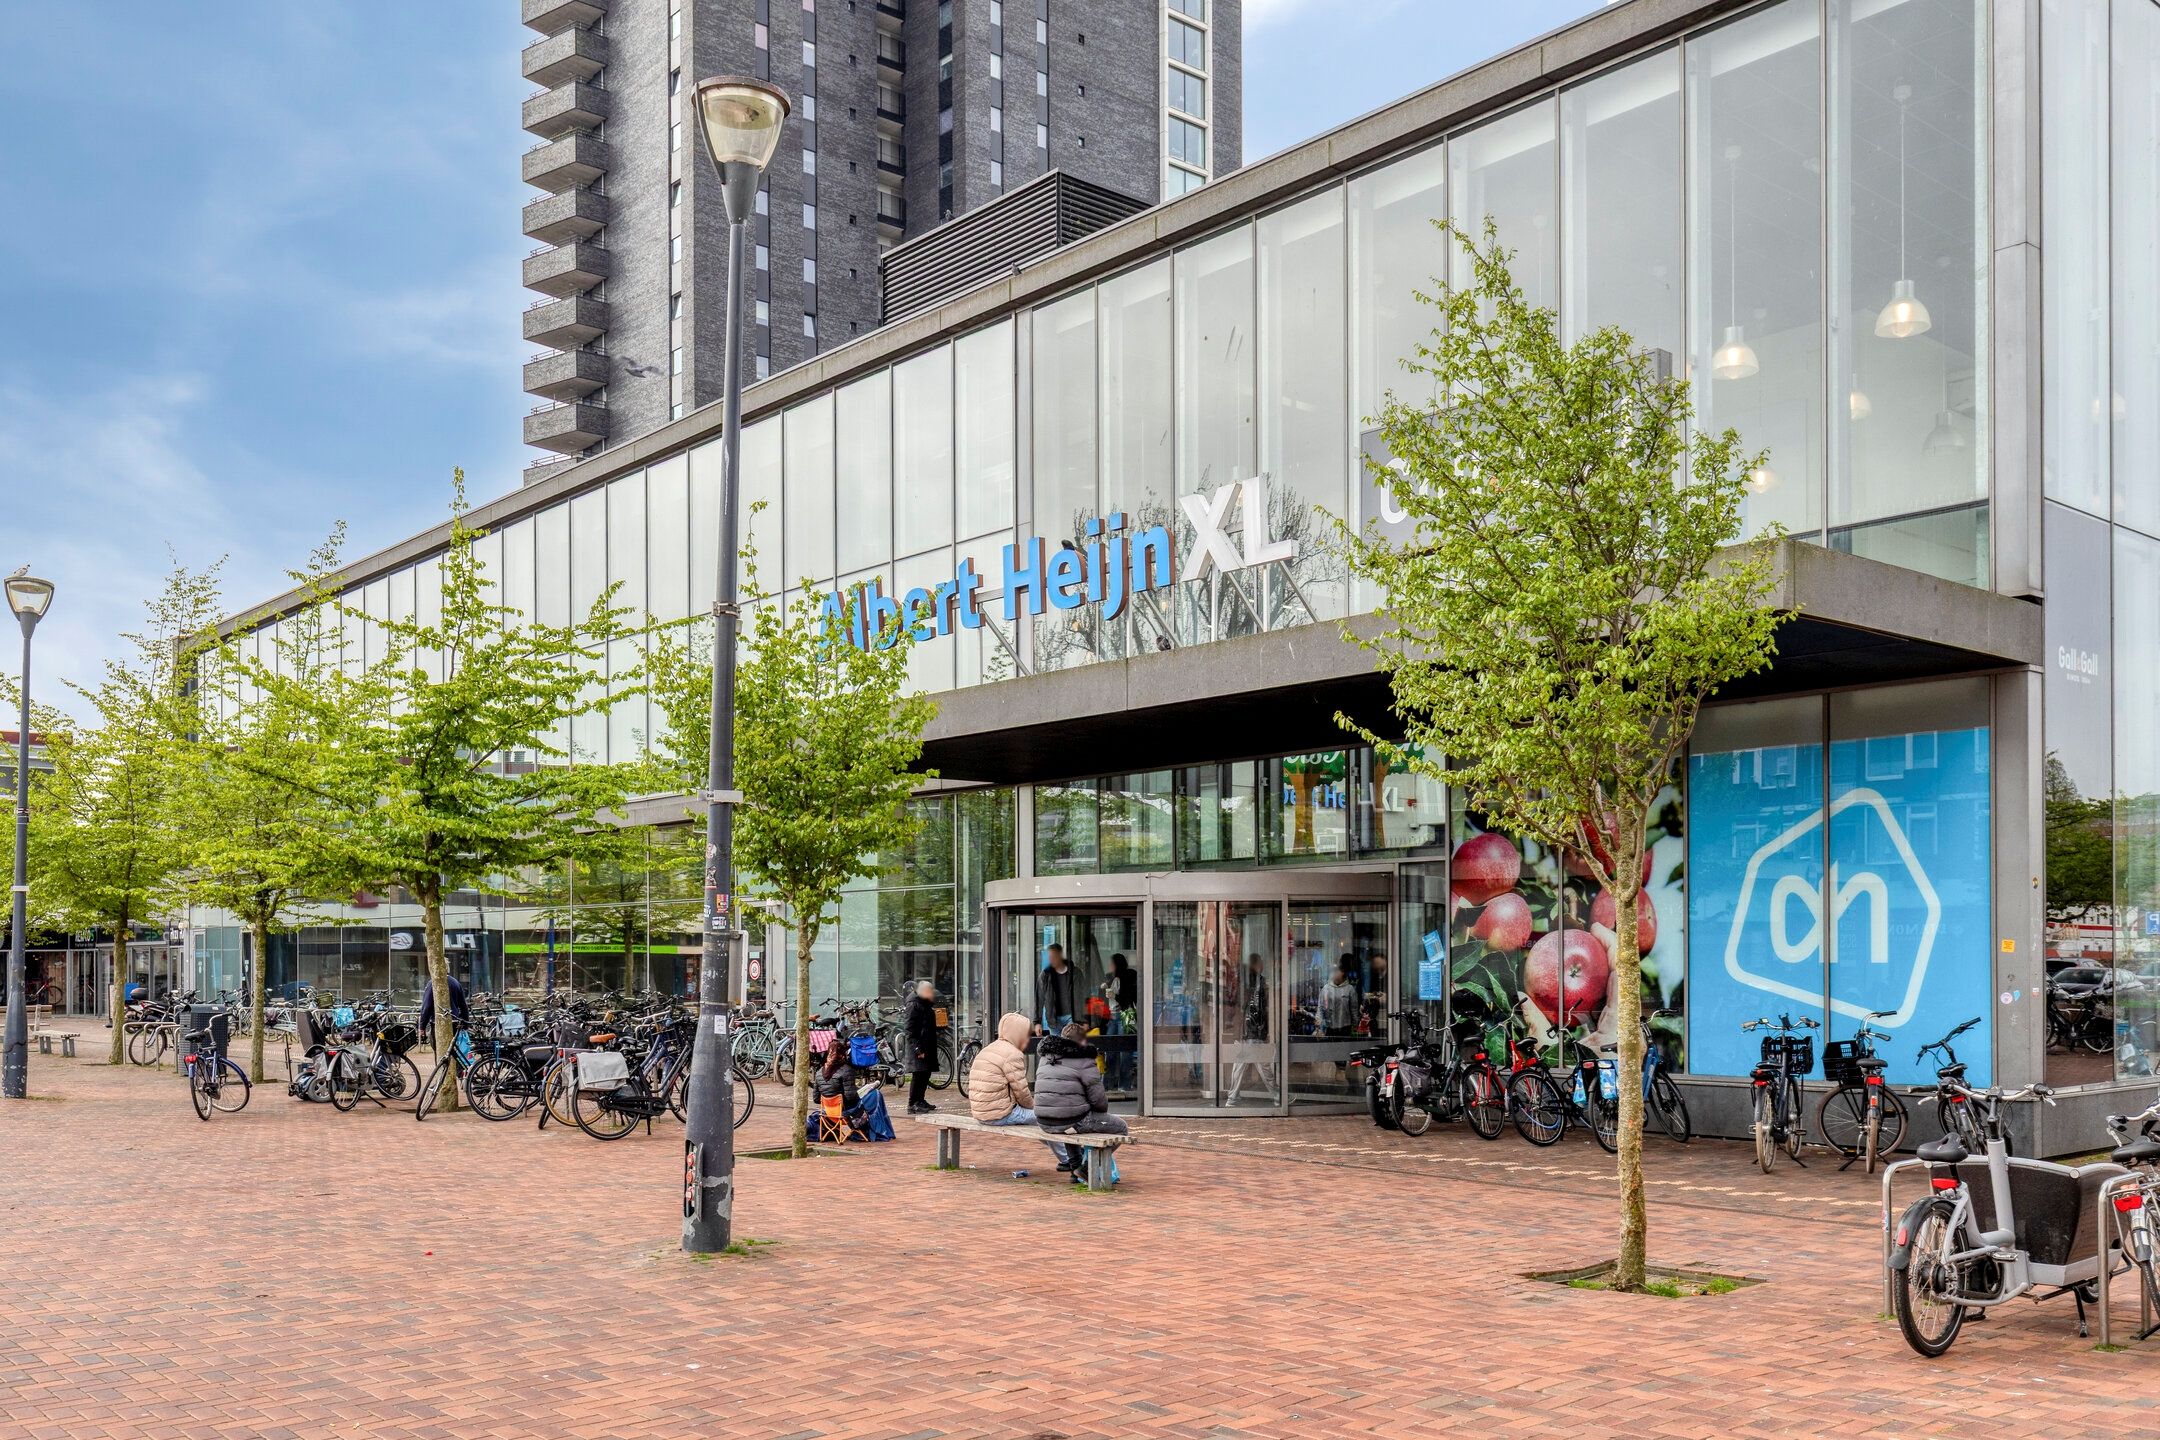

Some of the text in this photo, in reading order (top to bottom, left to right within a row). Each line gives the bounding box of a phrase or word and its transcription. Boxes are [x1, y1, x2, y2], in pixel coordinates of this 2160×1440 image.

[819, 557, 985, 659] Albert
[1003, 513, 1175, 621] Heijn
[1179, 475, 1299, 582] XL
